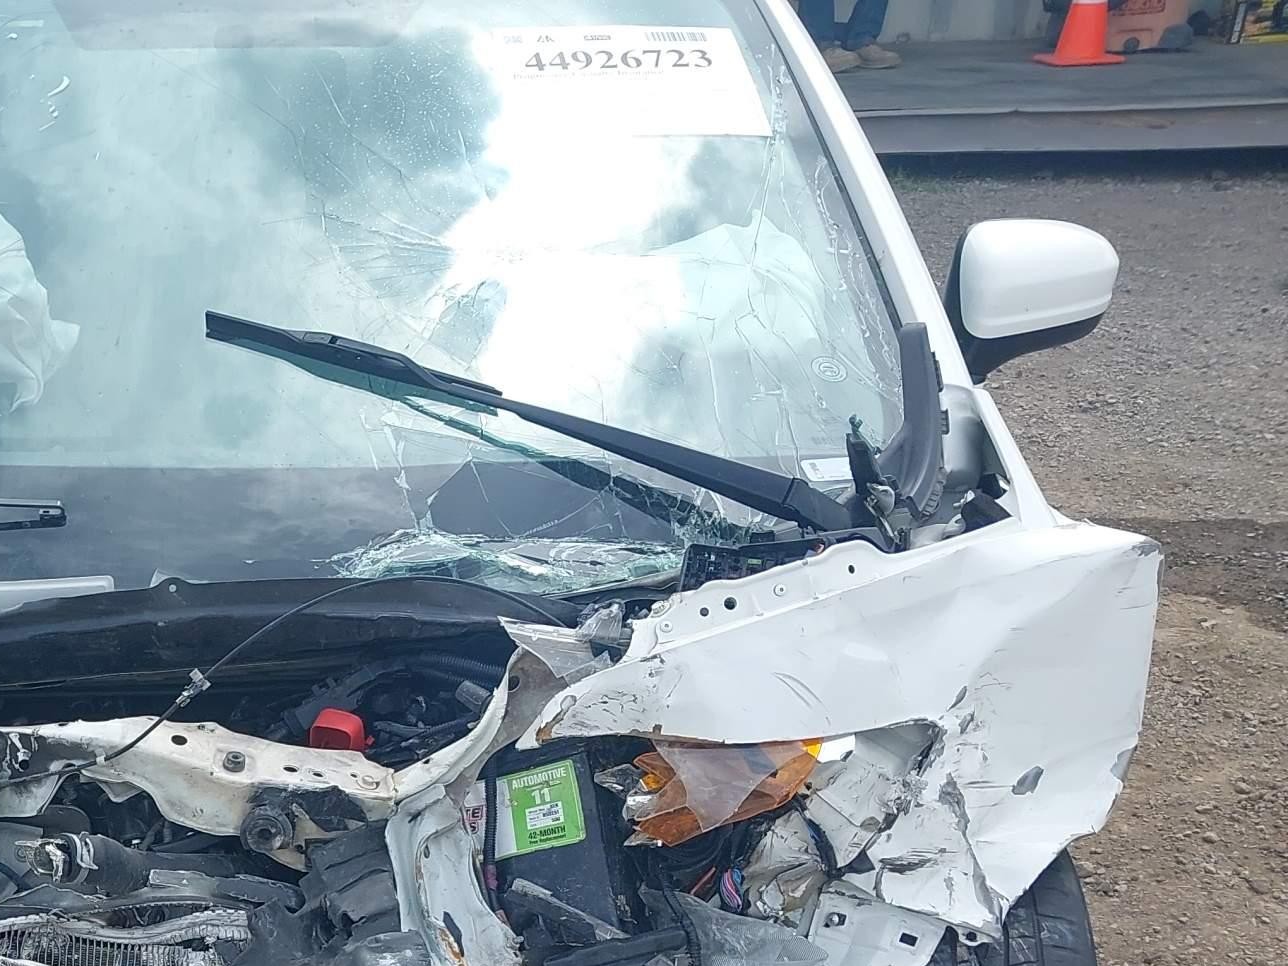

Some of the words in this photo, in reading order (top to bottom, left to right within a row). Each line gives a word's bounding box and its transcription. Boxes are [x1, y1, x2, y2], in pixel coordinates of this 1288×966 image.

[524, 49, 712, 71] 44926723
[512, 767, 567, 790] AUTOMOTIVE
[531, 787, 551, 805] 11
[528, 825, 566, 840] 42-MONTH
